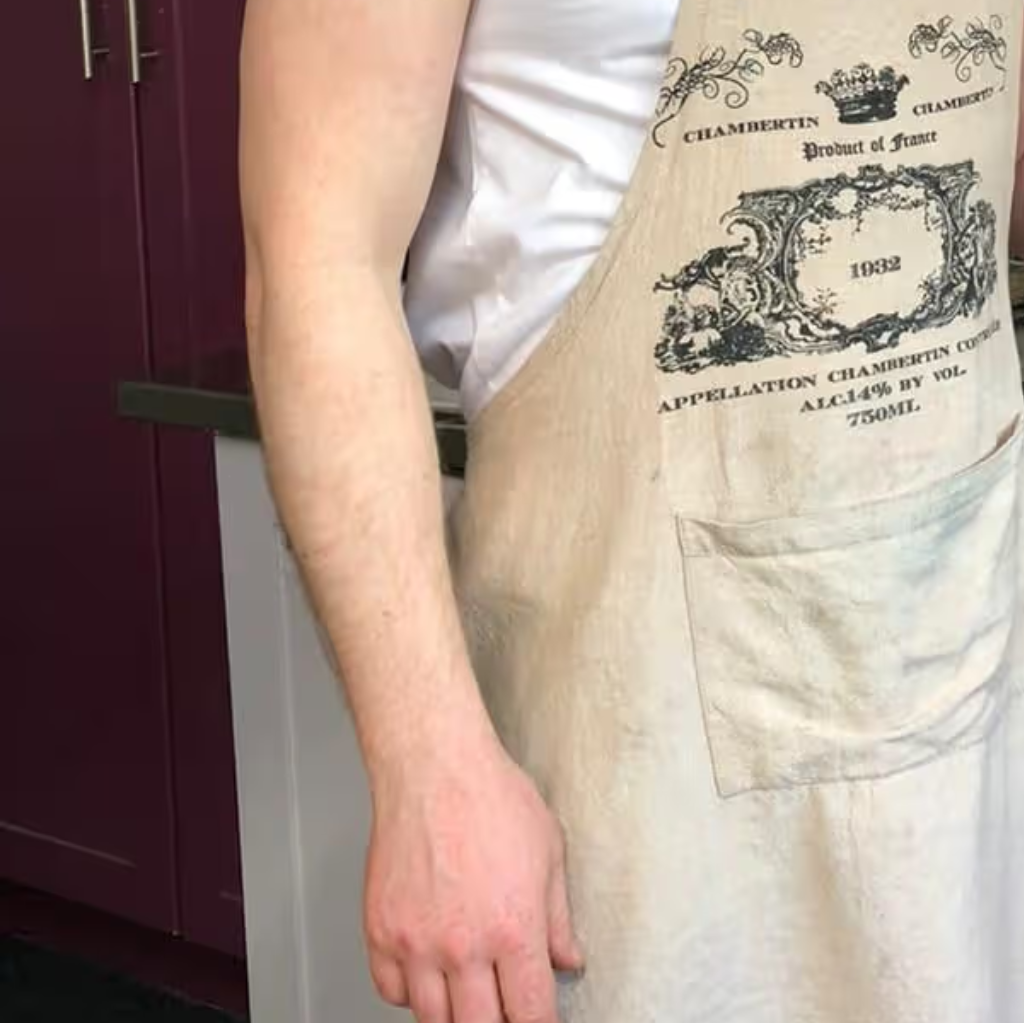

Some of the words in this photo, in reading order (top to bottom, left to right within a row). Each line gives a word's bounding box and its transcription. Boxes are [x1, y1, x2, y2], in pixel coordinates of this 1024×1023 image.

[683, 116, 819, 144] CHAMBERTIN
[802, 141, 863, 162] Product
[870, 136, 885, 152] of
[889, 131, 937, 153] France
[850, 255, 901, 279] 1932
[657, 375, 817, 414] APPELLATION
[827, 345, 949, 383] CHAMBERTIN
[899, 376, 923, 392] BY
[933, 364, 967, 382] VOL.
[847, 398, 921, 427] 750ML
